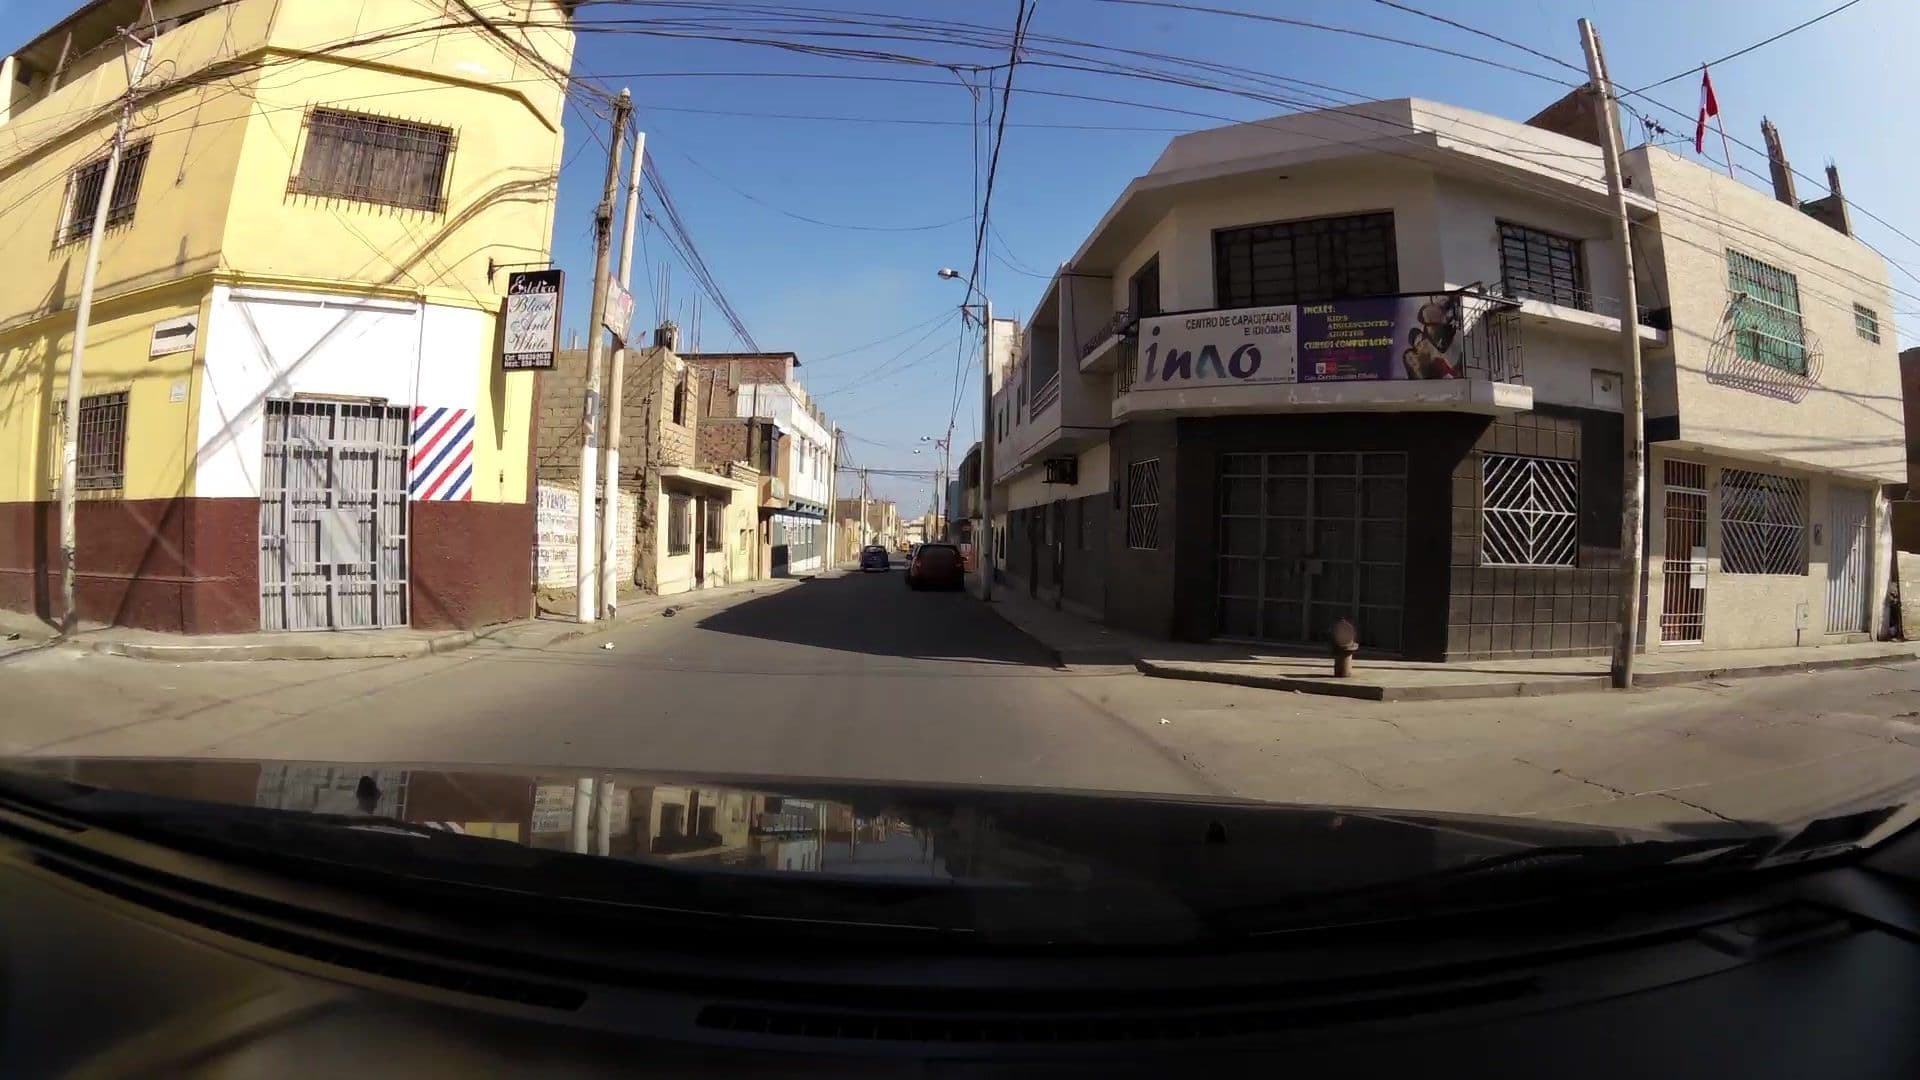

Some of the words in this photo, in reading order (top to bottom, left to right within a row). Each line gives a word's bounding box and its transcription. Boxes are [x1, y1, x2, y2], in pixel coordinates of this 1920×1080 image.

[509, 296, 553, 313] Black
[511, 313, 552, 332] And
[1186, 317, 1217, 330] CENTRO
[1219, 316, 1231, 327] DE
[1244, 327, 1251, 336] E
[1252, 325, 1291, 336] IDIOMAS
[508, 333, 548, 351] White
